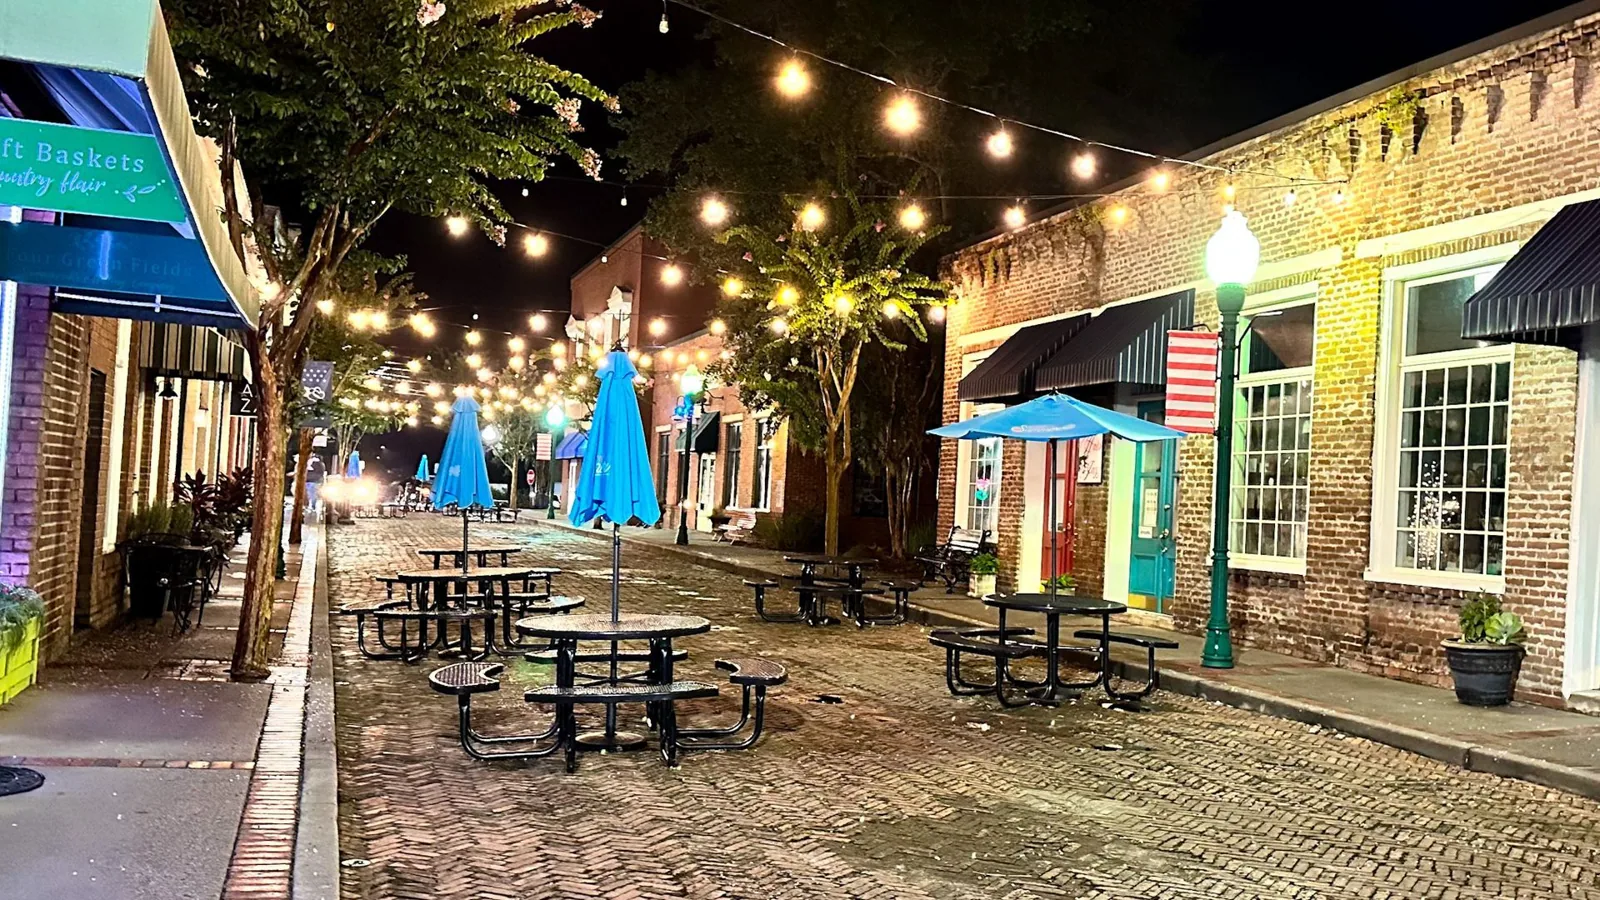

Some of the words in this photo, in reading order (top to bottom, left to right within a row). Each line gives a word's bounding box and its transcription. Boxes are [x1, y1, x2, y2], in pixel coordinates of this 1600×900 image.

[37, 142, 144, 173] Baskets
[60, 170, 106, 194] flair
[61, 252, 122, 271] Gren
